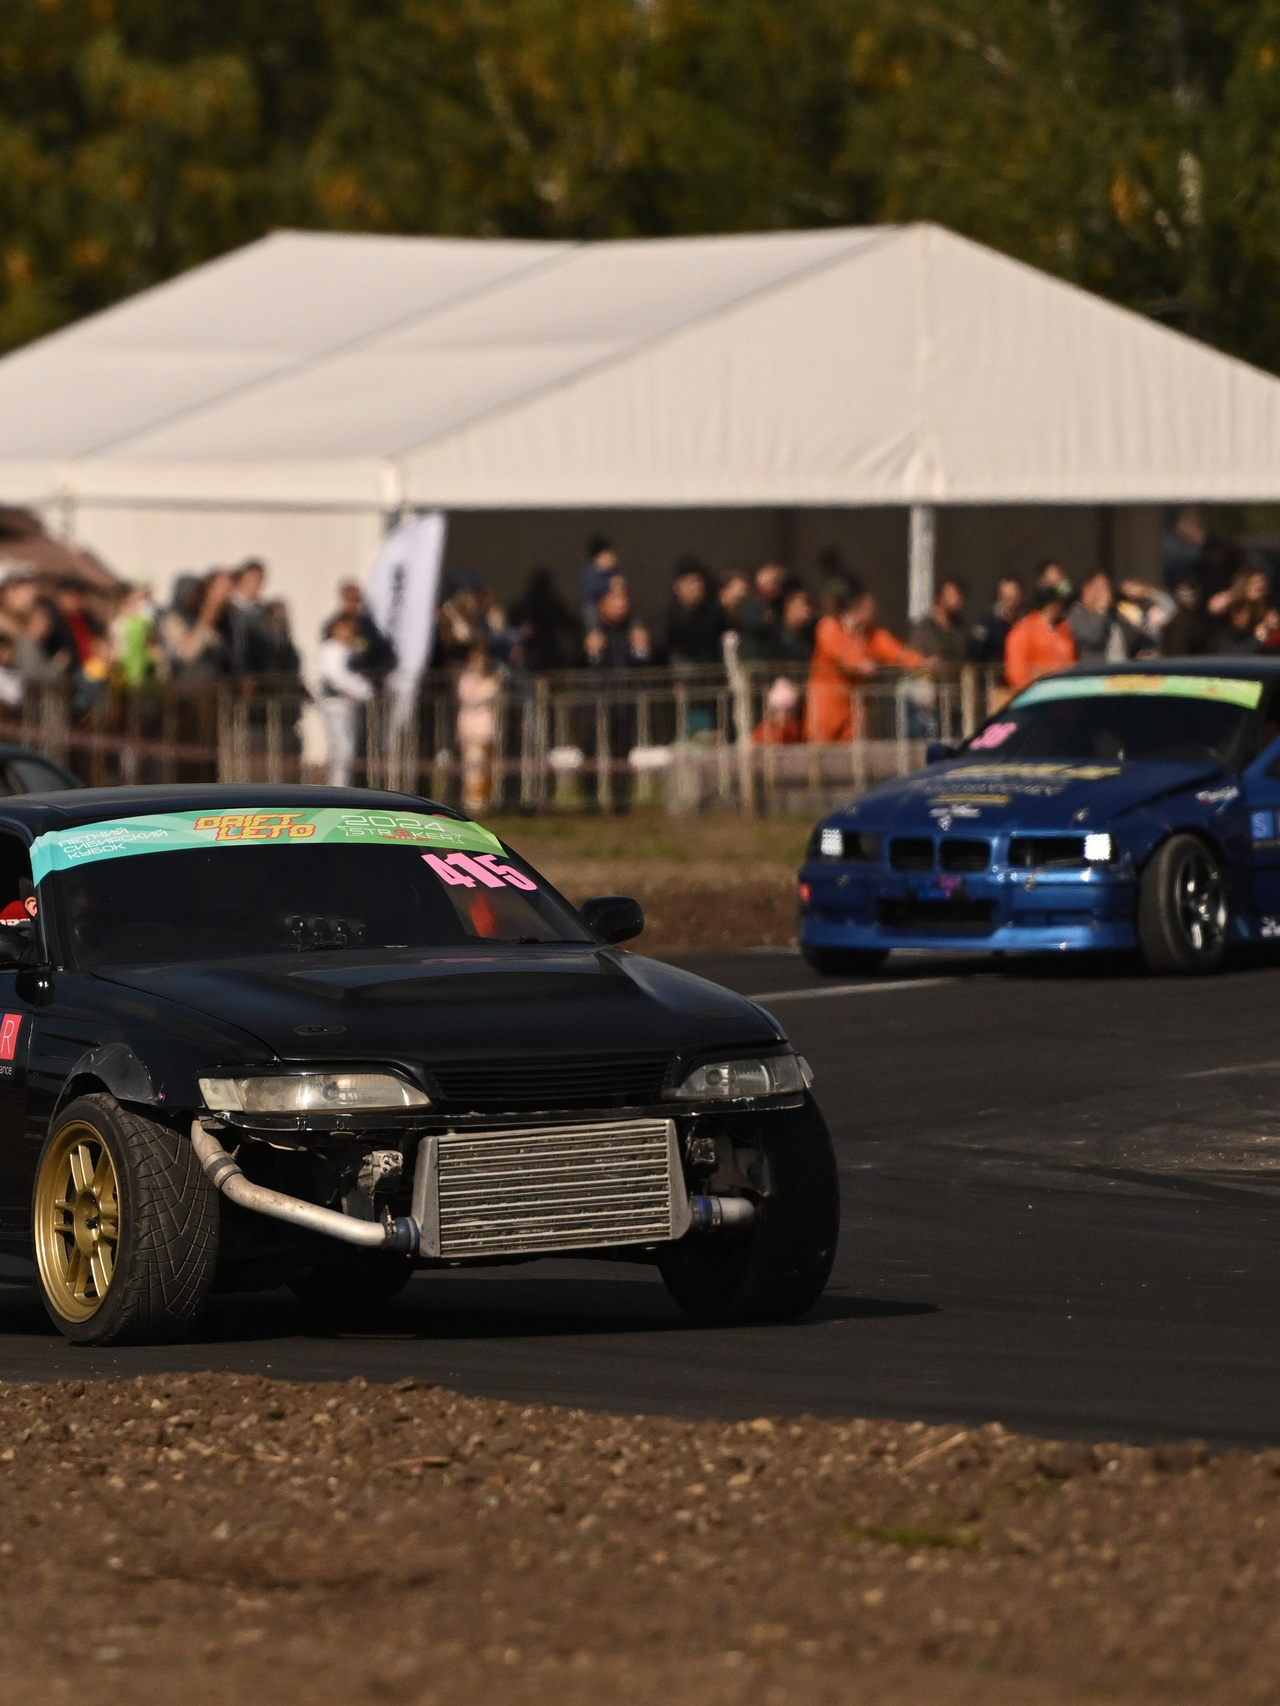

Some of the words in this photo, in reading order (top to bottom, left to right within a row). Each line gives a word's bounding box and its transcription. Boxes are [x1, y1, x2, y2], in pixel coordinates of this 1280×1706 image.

[194, 813, 306, 830] DRIFT
[340, 815, 446, 832] 2024
[58, 827, 129, 848] ЛЕТНИЙ
[63, 829, 168, 853] СИБИРСКИЙ
[215, 823, 317, 841] LETO
[67, 843, 127, 860] КУБОК
[421, 852, 538, 891] 415
